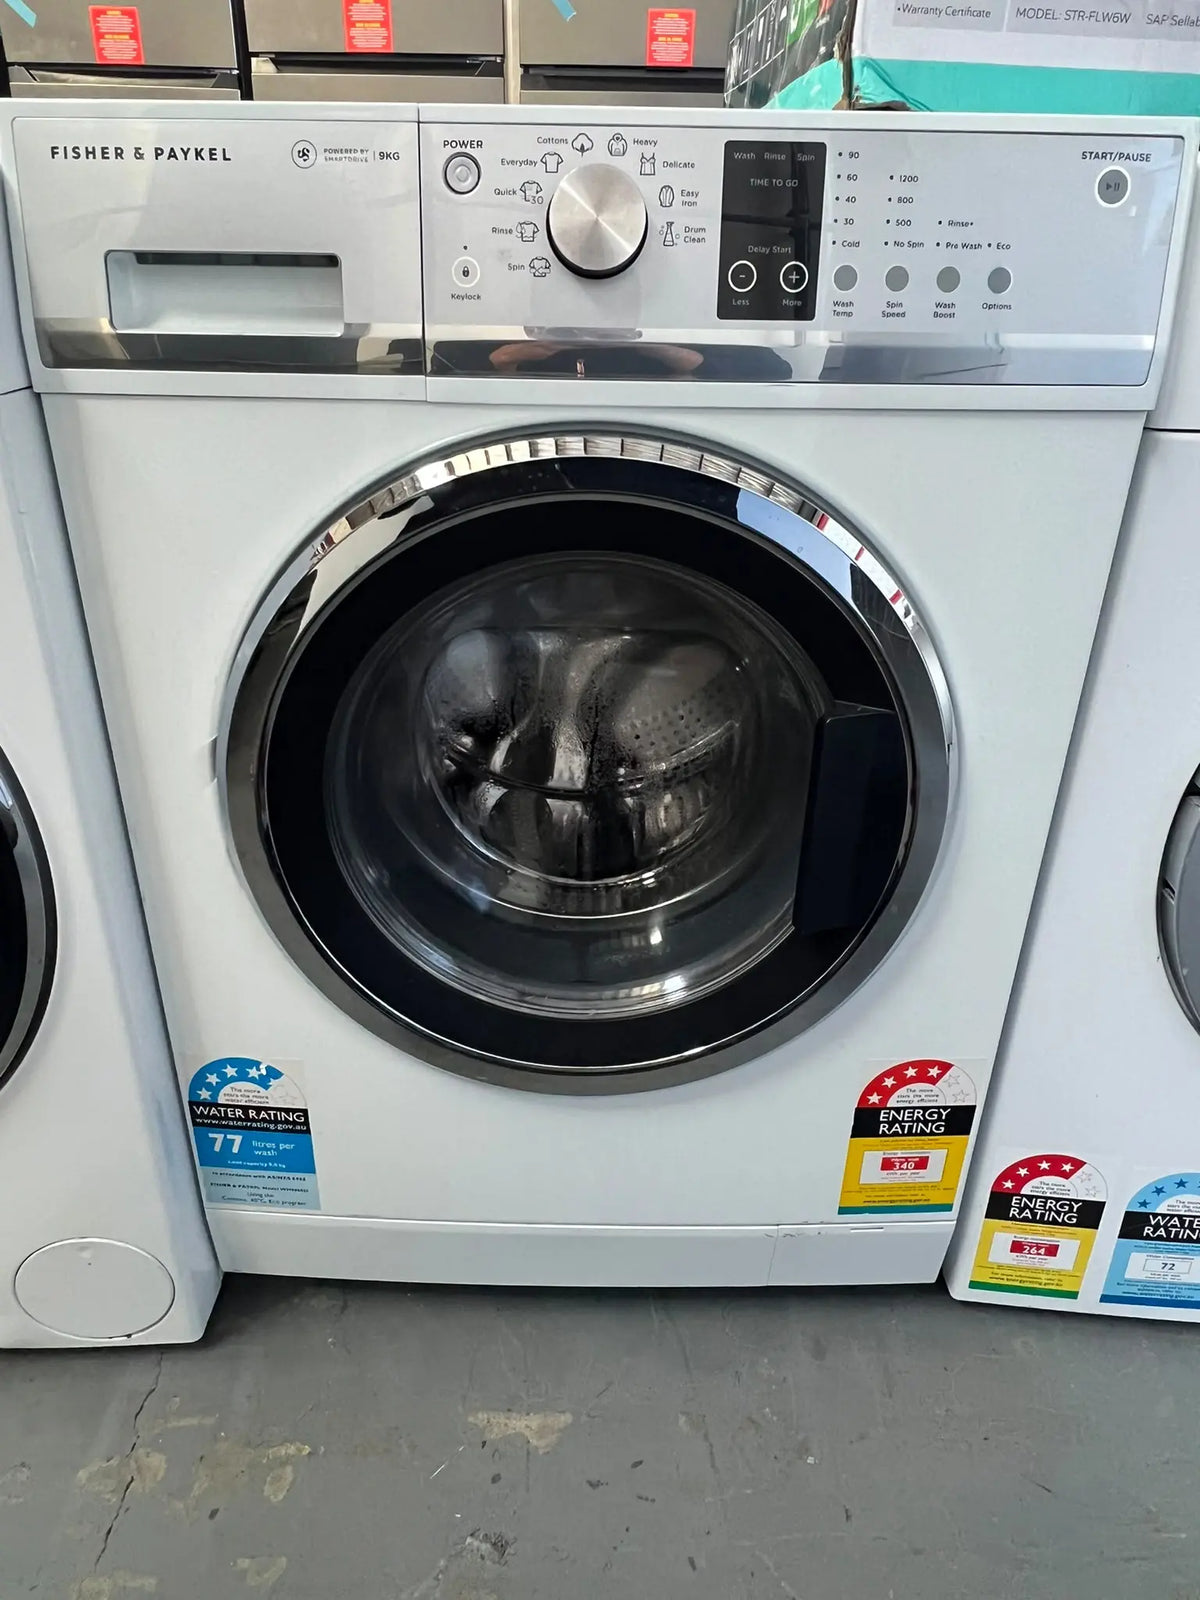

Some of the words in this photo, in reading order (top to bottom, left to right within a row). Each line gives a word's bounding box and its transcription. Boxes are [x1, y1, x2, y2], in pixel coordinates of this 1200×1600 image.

[902, 4, 943, 18] Warranty
[945, 6, 992, 18] Certificate
[1064, 10, 1132, 23] STR-FLW6W
[1146, 14, 1169, 25] SAP
[443, 140, 483, 149] POWER
[537, 136, 568, 145] Cottons
[633, 138, 657, 148] Heavy
[50, 146, 125, 160] FISHER
[133, 147, 145, 160] &
[154, 147, 232, 161] PAYKEL
[378, 151, 400, 161] 9KG
[734, 152, 756, 160] Wash
[764, 152, 786, 161] Rinse
[797, 153, 815, 162] Spin
[849, 151, 859, 159] 90
[1081, 151, 1152, 162] START/PAUSE
[500, 158, 537, 168] Everyday
[662, 160, 695, 169] Delicate
[750, 178, 769, 186] TIME
[772, 179, 783, 187] TO
[785, 179, 798, 187] GO
[846, 174, 858, 182] 60
[899, 175, 919, 183] 1200
[494, 187, 517, 197] Quick
[680, 189, 699, 200] Easy
[530, 196, 544, 205] 30
[845, 196, 857, 204] 40
[897, 196, 914, 204] 800
[843, 218, 855, 226] 30
[895, 219, 912, 227] 500
[491, 226, 513, 235] Rinse
[684, 226, 706, 234] Drum
[683, 235, 706, 243] Clean
[841, 240, 860, 248] Cold
[893, 240, 905, 248] No
[907, 240, 924, 249] Spin
[945, 241, 959, 250] Pre
[961, 242, 982, 250] Wash
[996, 242, 1011, 250] Eco
[748, 246, 770, 254] Delay
[772, 246, 791, 254] Start
[507, 263, 525, 272] Spin
[451, 293, 481, 302] Keylock
[732, 298, 750, 306] Less
[782, 299, 802, 307] More
[833, 300, 854, 308] Wash
[886, 301, 903, 309] Spin
[935, 301, 956, 309] Wash
[981, 302, 1012, 311] Options
[832, 309, 854, 318] Temp
[881, 310, 906, 319] Speed
[933, 311, 955, 319] Boost
[193, 1105, 245, 1119] WATER
[248, 1110, 305, 1123] RATING
[880, 1108, 951, 1122] ENERGY
[196, 1118, 307, 1131] www.waterrating.gov.au
[879, 1122, 945, 1135] RATING
[208, 1133, 243, 1154] 77
[252, 1139, 276, 1149] litres
[279, 1143, 295, 1151] per
[254, 1149, 277, 1157] wash
[893, 1161, 915, 1170] 340
[1011, 1196, 1082, 1212] ENERGY
[1009, 1207, 1078, 1224] RATING
[1143, 1226, 1200, 1240] RATIN
[1022, 1245, 1046, 1255] 264
[1161, 1262, 1176, 1271] 72
